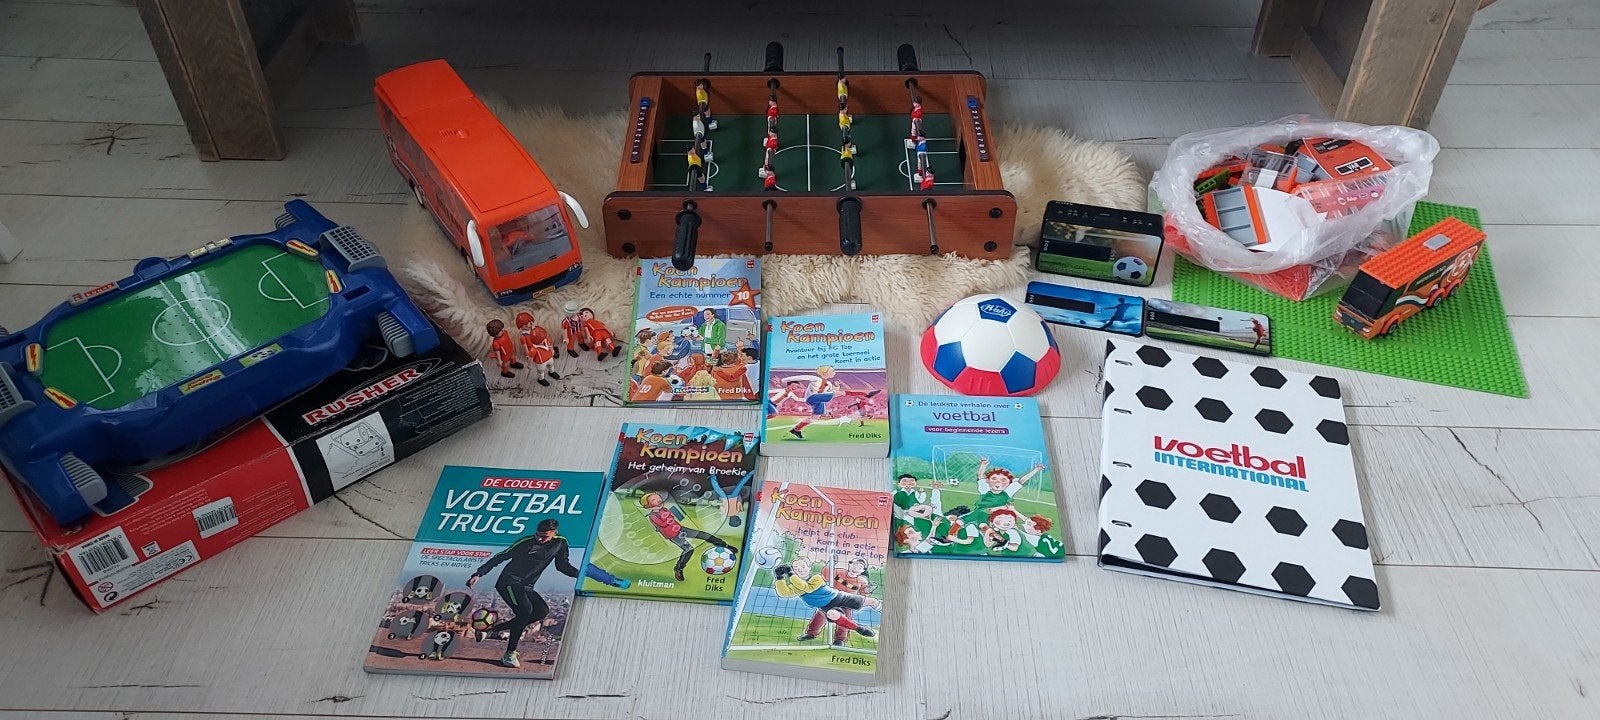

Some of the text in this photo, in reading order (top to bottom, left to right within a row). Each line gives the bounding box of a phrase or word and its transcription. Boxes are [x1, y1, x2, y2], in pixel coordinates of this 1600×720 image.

[650, 291, 665, 299] Een
[669, 291, 693, 299] echte
[737, 291, 750, 300] 10
[780, 321, 825, 333] Koen
[821, 352, 840, 360] grote
[842, 349, 870, 357] toernooi
[639, 384, 652, 393] 10
[302, 367, 423, 426] RUSHER
[933, 411, 996, 422] voetbal
[636, 428, 688, 445] Koen
[640, 441, 743, 464] Kampioen
[1154, 435, 1307, 479] voetbal
[628, 461, 747, 476] Het geheim van Broekie
[1154, 451, 1309, 492] INTERNATIONAL
[483, 478, 559, 490] DE COOLSTE
[445, 489, 583, 515] VOETBAL
[771, 487, 823, 508] Koen
[776, 501, 880, 530] Kampioen
[437, 512, 530, 534] TRUCS
[798, 527, 820, 537] helpt
[824, 530, 835, 538] de
[854, 543, 876, 551] actie
[831, 548, 852, 556] naar
[855, 550, 866, 558] de
[869, 552, 884, 561] top
[637, 579, 675, 588] kluitman
[706, 576, 726, 584] Fred
[705, 584, 723, 592] Diks
[831, 655, 871, 666] Fred Diks
